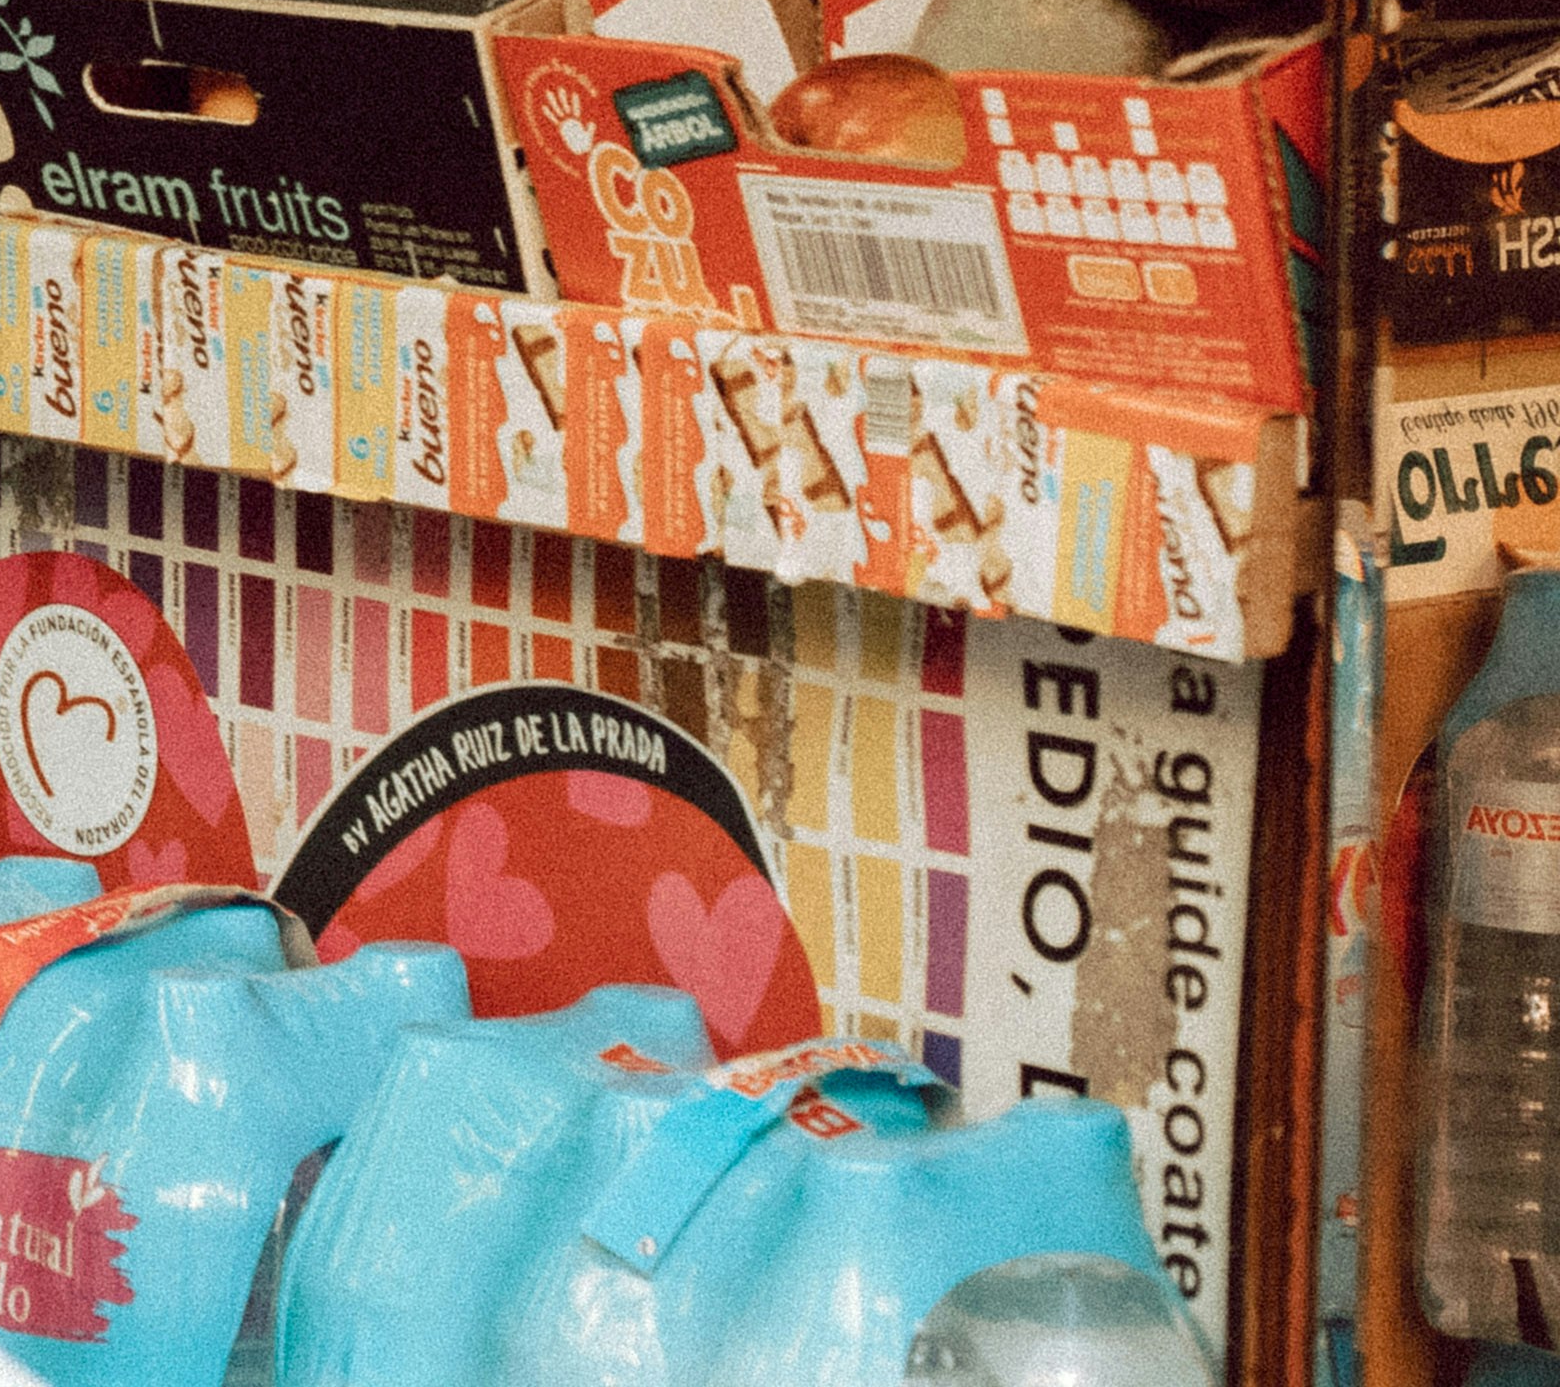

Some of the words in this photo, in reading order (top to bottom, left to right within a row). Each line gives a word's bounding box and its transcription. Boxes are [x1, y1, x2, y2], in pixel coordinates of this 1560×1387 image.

[40, 151, 201, 223] elram
[209, 167, 351, 242] fruits
[32, 315, 45, 378] Kinder
[45, 277, 78, 420] bueno
[139, 329, 154, 396] Kinder
[398, 376, 412, 443] Kinder
[412, 338, 445, 487] bueno
[1014, 379, 1042, 507] ueno
[28, 613, 111, 651] FUNDACIÓN
[110, 650, 151, 758] ESPAÑOLA
[1170, 666, 1219, 716] a
[128, 764, 148, 802] DEL
[341, 818, 370, 855] BY
[364, 745, 457, 834] AGATHA
[450, 720, 512, 775] RUIZ
[514, 713, 550, 758] DE
[550, 711, 589, 754] LA
[589, 712, 667, 775] PRADA
[1012, 627, 1102, 997] EDIO,
[1154, 749, 1224, 1015] guide
[1163, 1047, 1208, 1300] coate
